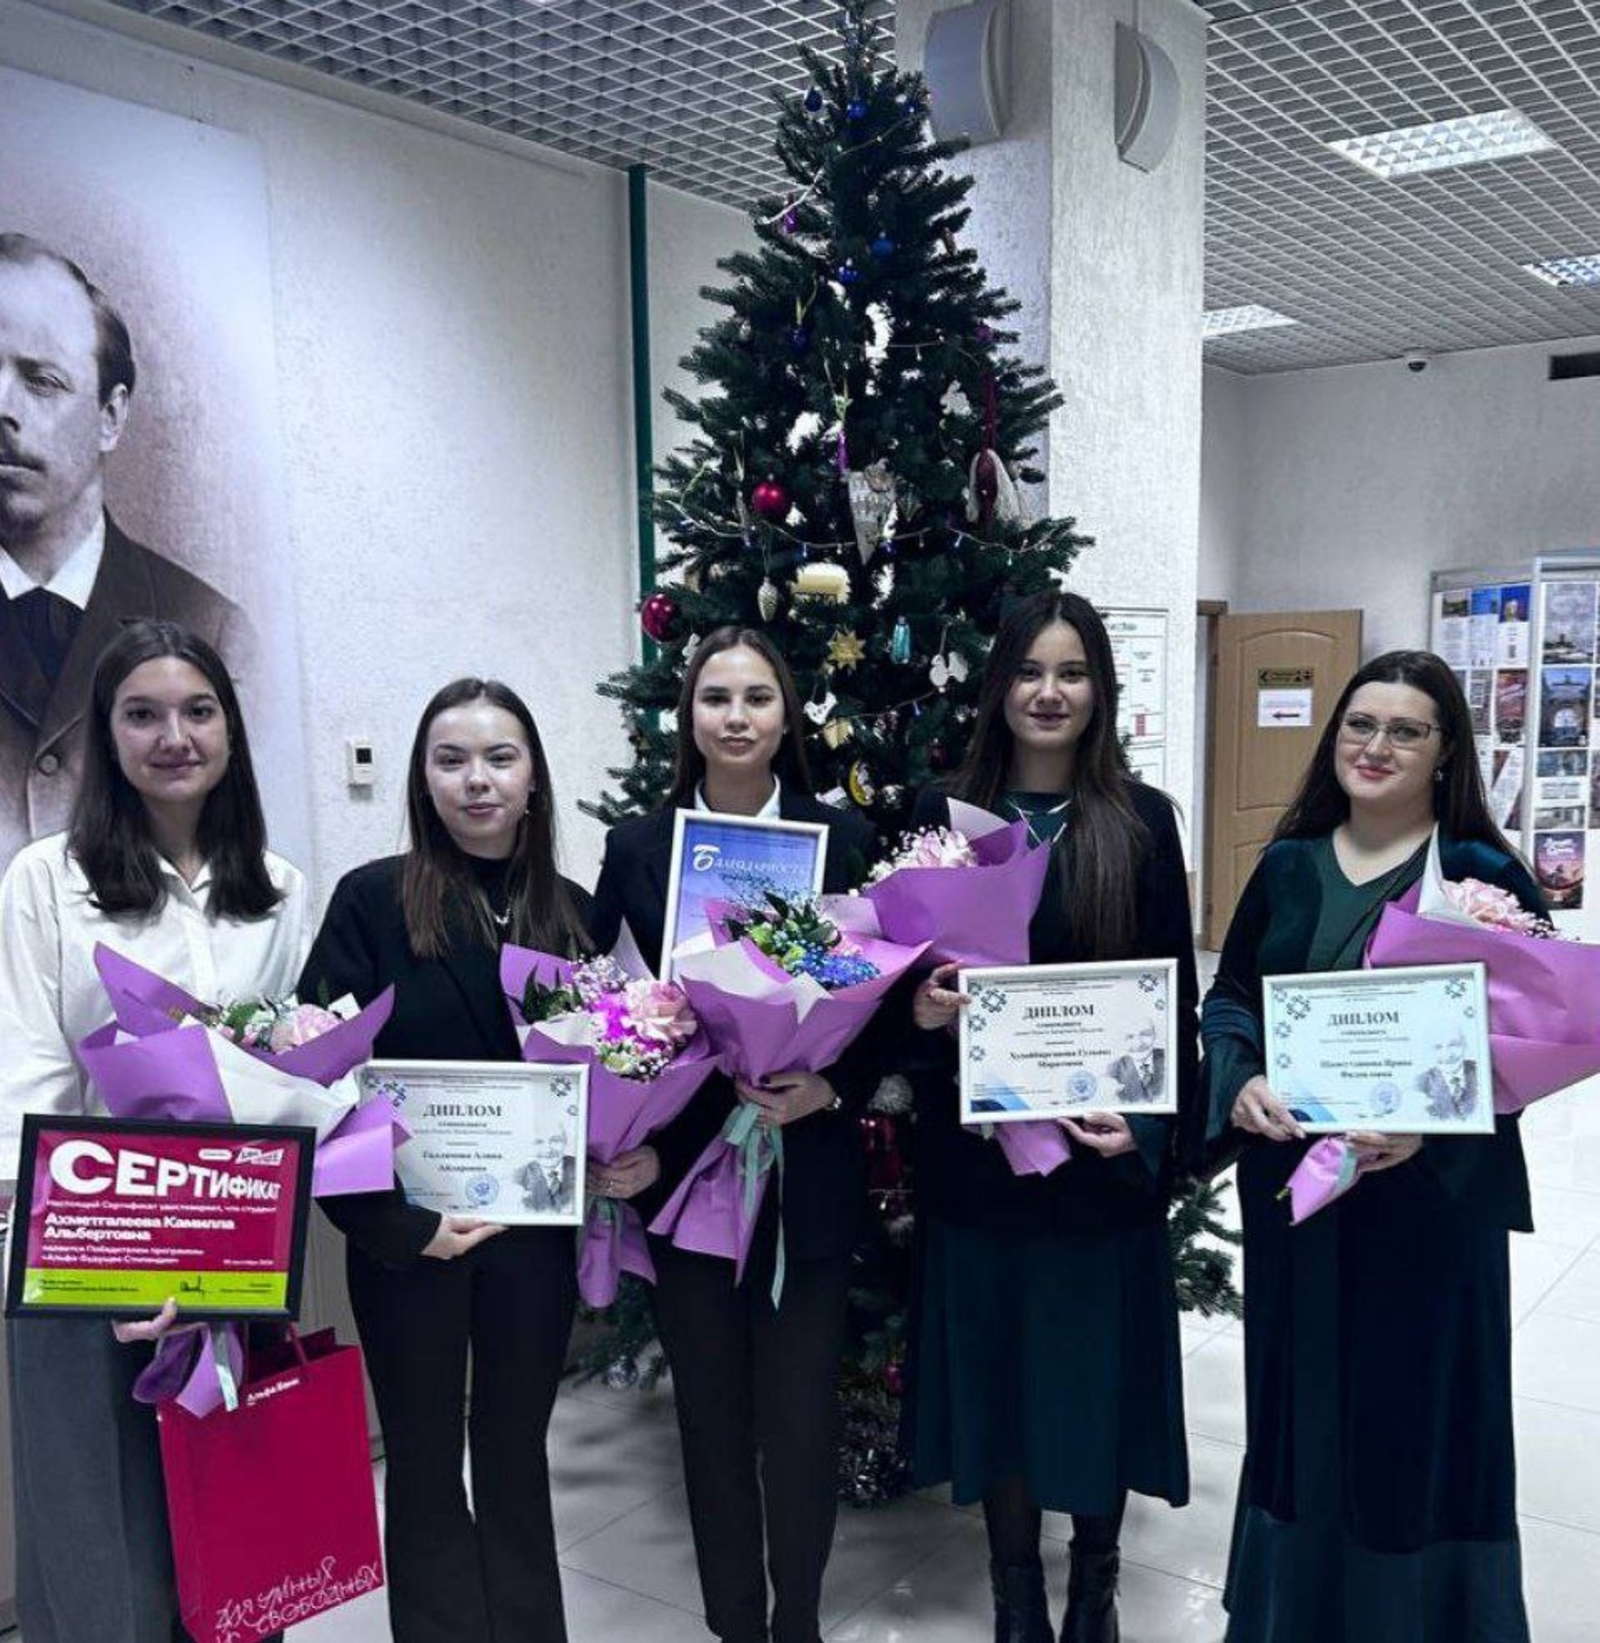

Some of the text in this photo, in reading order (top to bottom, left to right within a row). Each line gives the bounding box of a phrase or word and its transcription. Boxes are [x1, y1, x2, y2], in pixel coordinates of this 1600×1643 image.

[1022, 1004, 1095, 1020] ДИПЛОМ
[1327, 1011, 1400, 1026] ДИПЛОМ
[423, 1103, 502, 1118] ДИПЛОМ
[49, 1139, 281, 1200] СЕРТИФИКАТ
[164, 1216, 235, 1230] Камилла
[44, 1226, 151, 1241] Альбертовна
